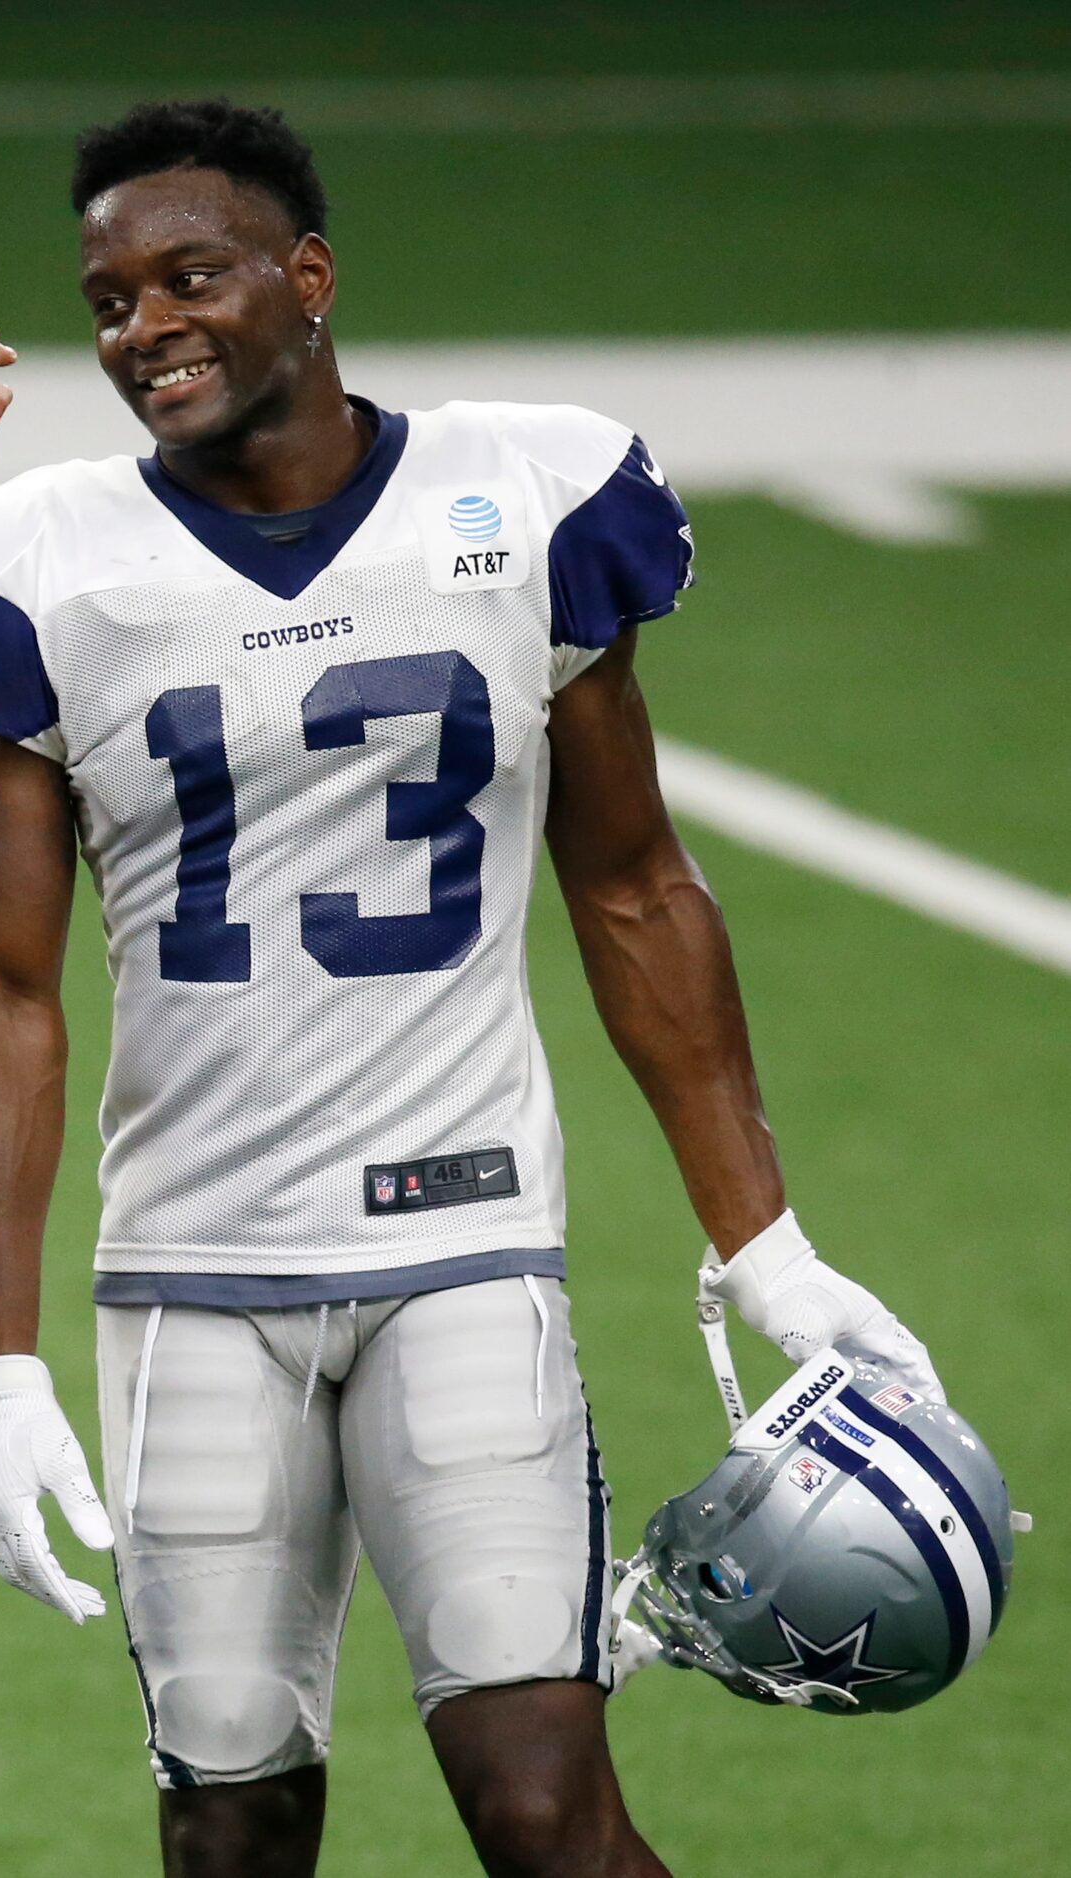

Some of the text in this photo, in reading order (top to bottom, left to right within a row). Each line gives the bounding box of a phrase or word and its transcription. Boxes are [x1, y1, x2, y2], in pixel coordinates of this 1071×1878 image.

[453, 552, 510, 578] AT&T
[242, 616, 354, 650] COWBOYS
[145, 650, 494, 982] 13
[433, 1162, 463, 1182] 46
[765, 1364, 845, 1439] COWBOYS
